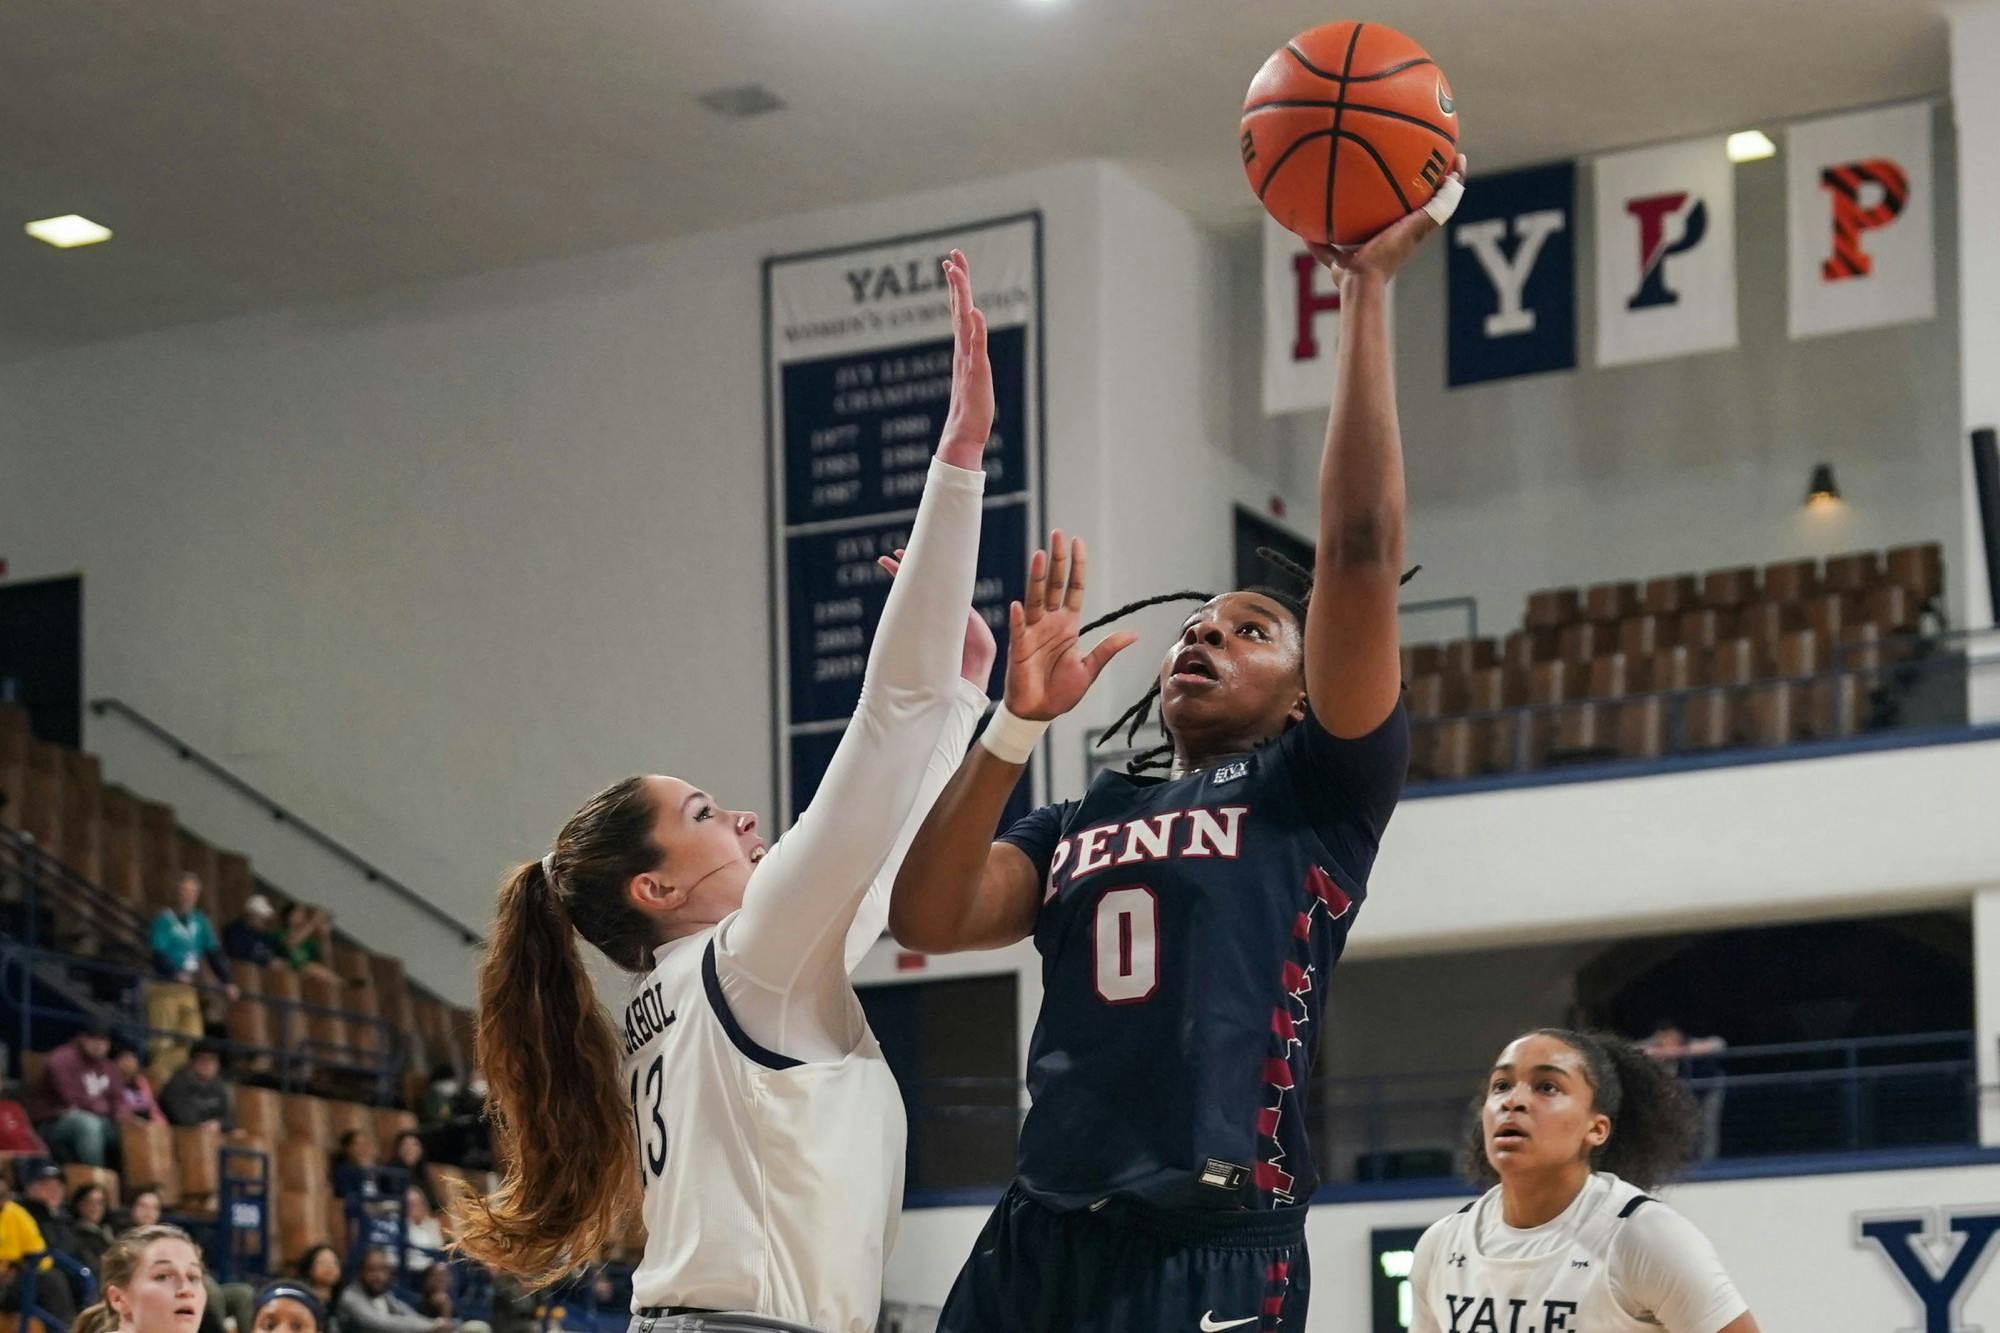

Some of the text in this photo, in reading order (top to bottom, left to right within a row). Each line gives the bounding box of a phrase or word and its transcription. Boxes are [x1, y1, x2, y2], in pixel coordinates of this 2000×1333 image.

[1454, 209, 1566, 339] Y
[1818, 158, 1911, 283] P
[1044, 804, 1250, 904] PENN
[1091, 883, 1162, 1005] 0
[625, 982, 677, 1056] ABOL
[631, 1054, 668, 1188] 13
[1446, 1294, 1578, 1333] YALE
[1853, 1205, 2000, 1333] Y
